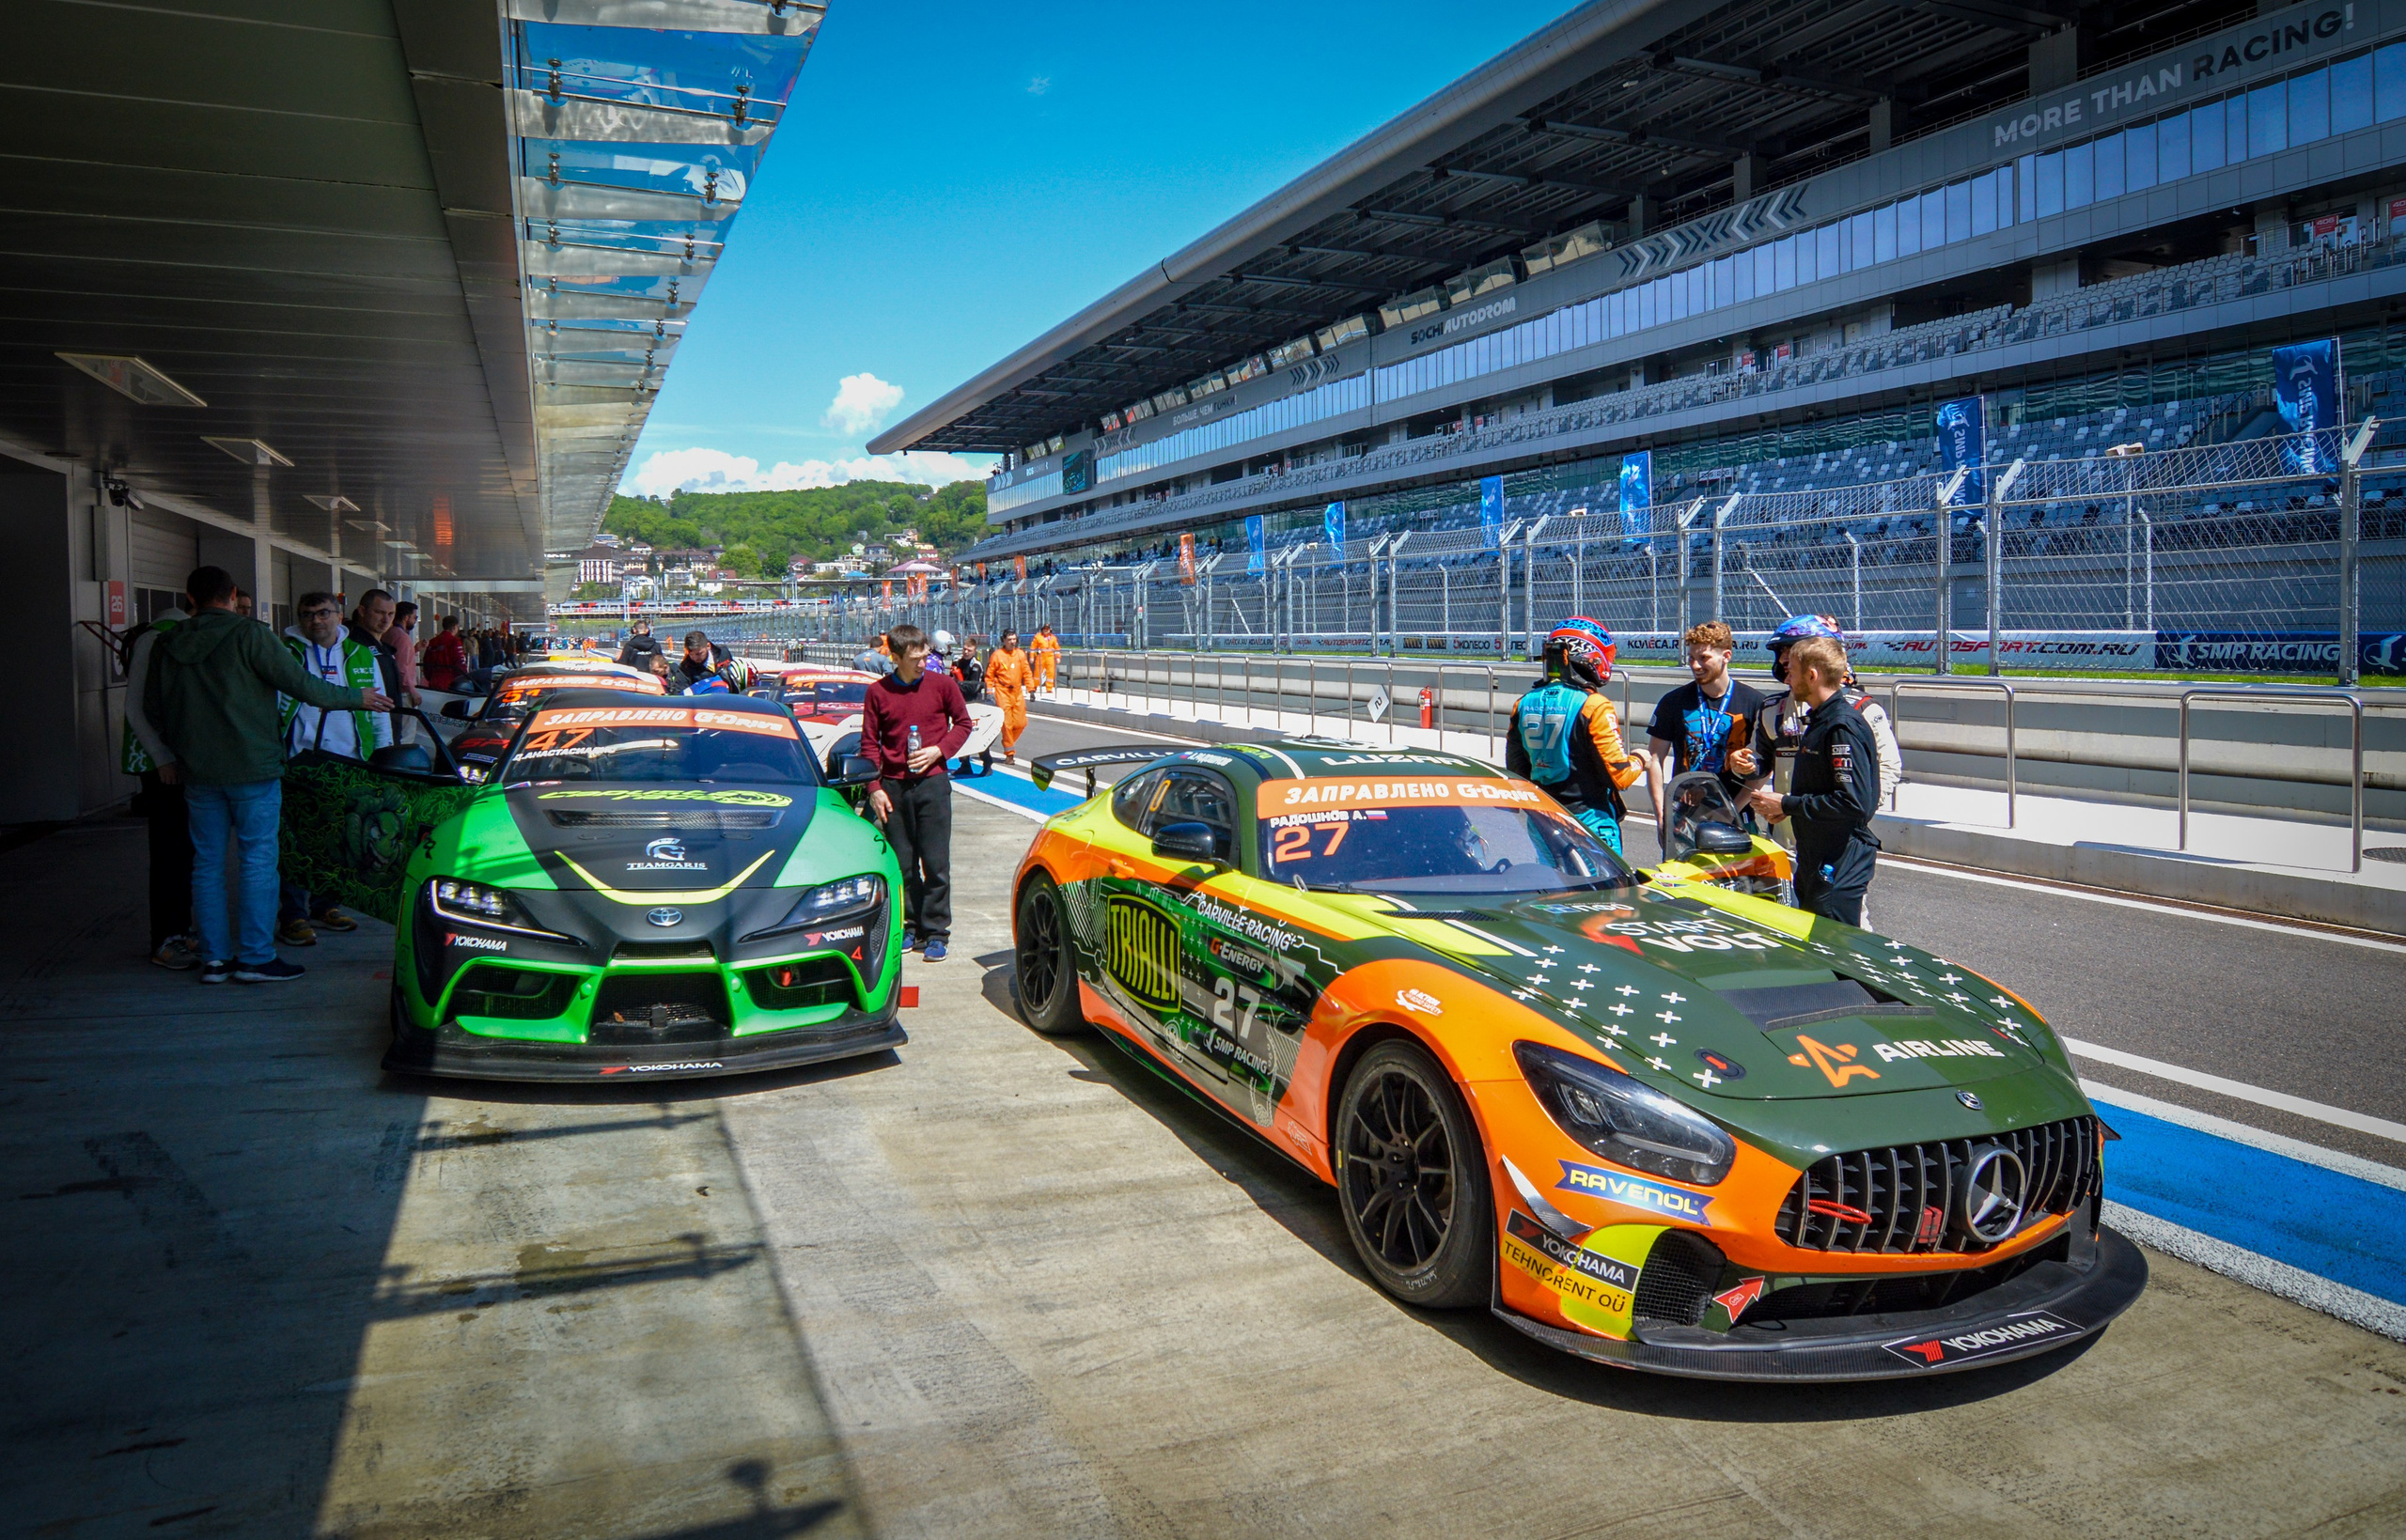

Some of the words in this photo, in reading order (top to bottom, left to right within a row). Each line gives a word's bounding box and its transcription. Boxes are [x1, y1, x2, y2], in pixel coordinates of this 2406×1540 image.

[1994, 98, 2083, 148] MORE
[2090, 63, 2181, 115] THAN
[2192, 4, 2355, 82] RACING!
[111, 595, 123, 613] 26
[2196, 643, 2247, 660] SMP
[2248, 643, 2342, 661] RACING
[543, 709, 687, 726] ЗАПРАВЛЕНО
[524, 727, 595, 750] 47
[1523, 713, 1567, 750] 27
[1320, 754, 1471, 768] LUZAR
[1284, 783, 1449, 804] ЗАПРАВЛЕНО
[1270, 809, 1350, 829] РАДОШНОВ
[1274, 822, 1350, 863] 27
[626, 862, 707, 870] TEAMGARIS
[821, 926, 865, 941] YOKOHAMA
[1604, 918, 1735, 937] START
[454, 935, 508, 952] YOKOHAMA
[1109, 904, 1176, 1002] TRIALLI
[1639, 931, 1783, 954] VOLT
[1213, 975, 1261, 1040] 27
[1213, 1038, 1235, 1058] SMP
[1234, 1046, 1270, 1075] RACING
[1872, 1039, 2006, 1063] AIRLINE
[628, 1062, 724, 1072] YOKOHAMA
[1570, 1169, 1699, 1216] RAVENOL
[1542, 1233, 1625, 1284] YOKOHAMA
[1504, 1239, 1597, 1300] TEHNORENT
[1599, 1290, 1626, 1313] OÜ
[1941, 1318, 2066, 1352] YOKOHAMA
